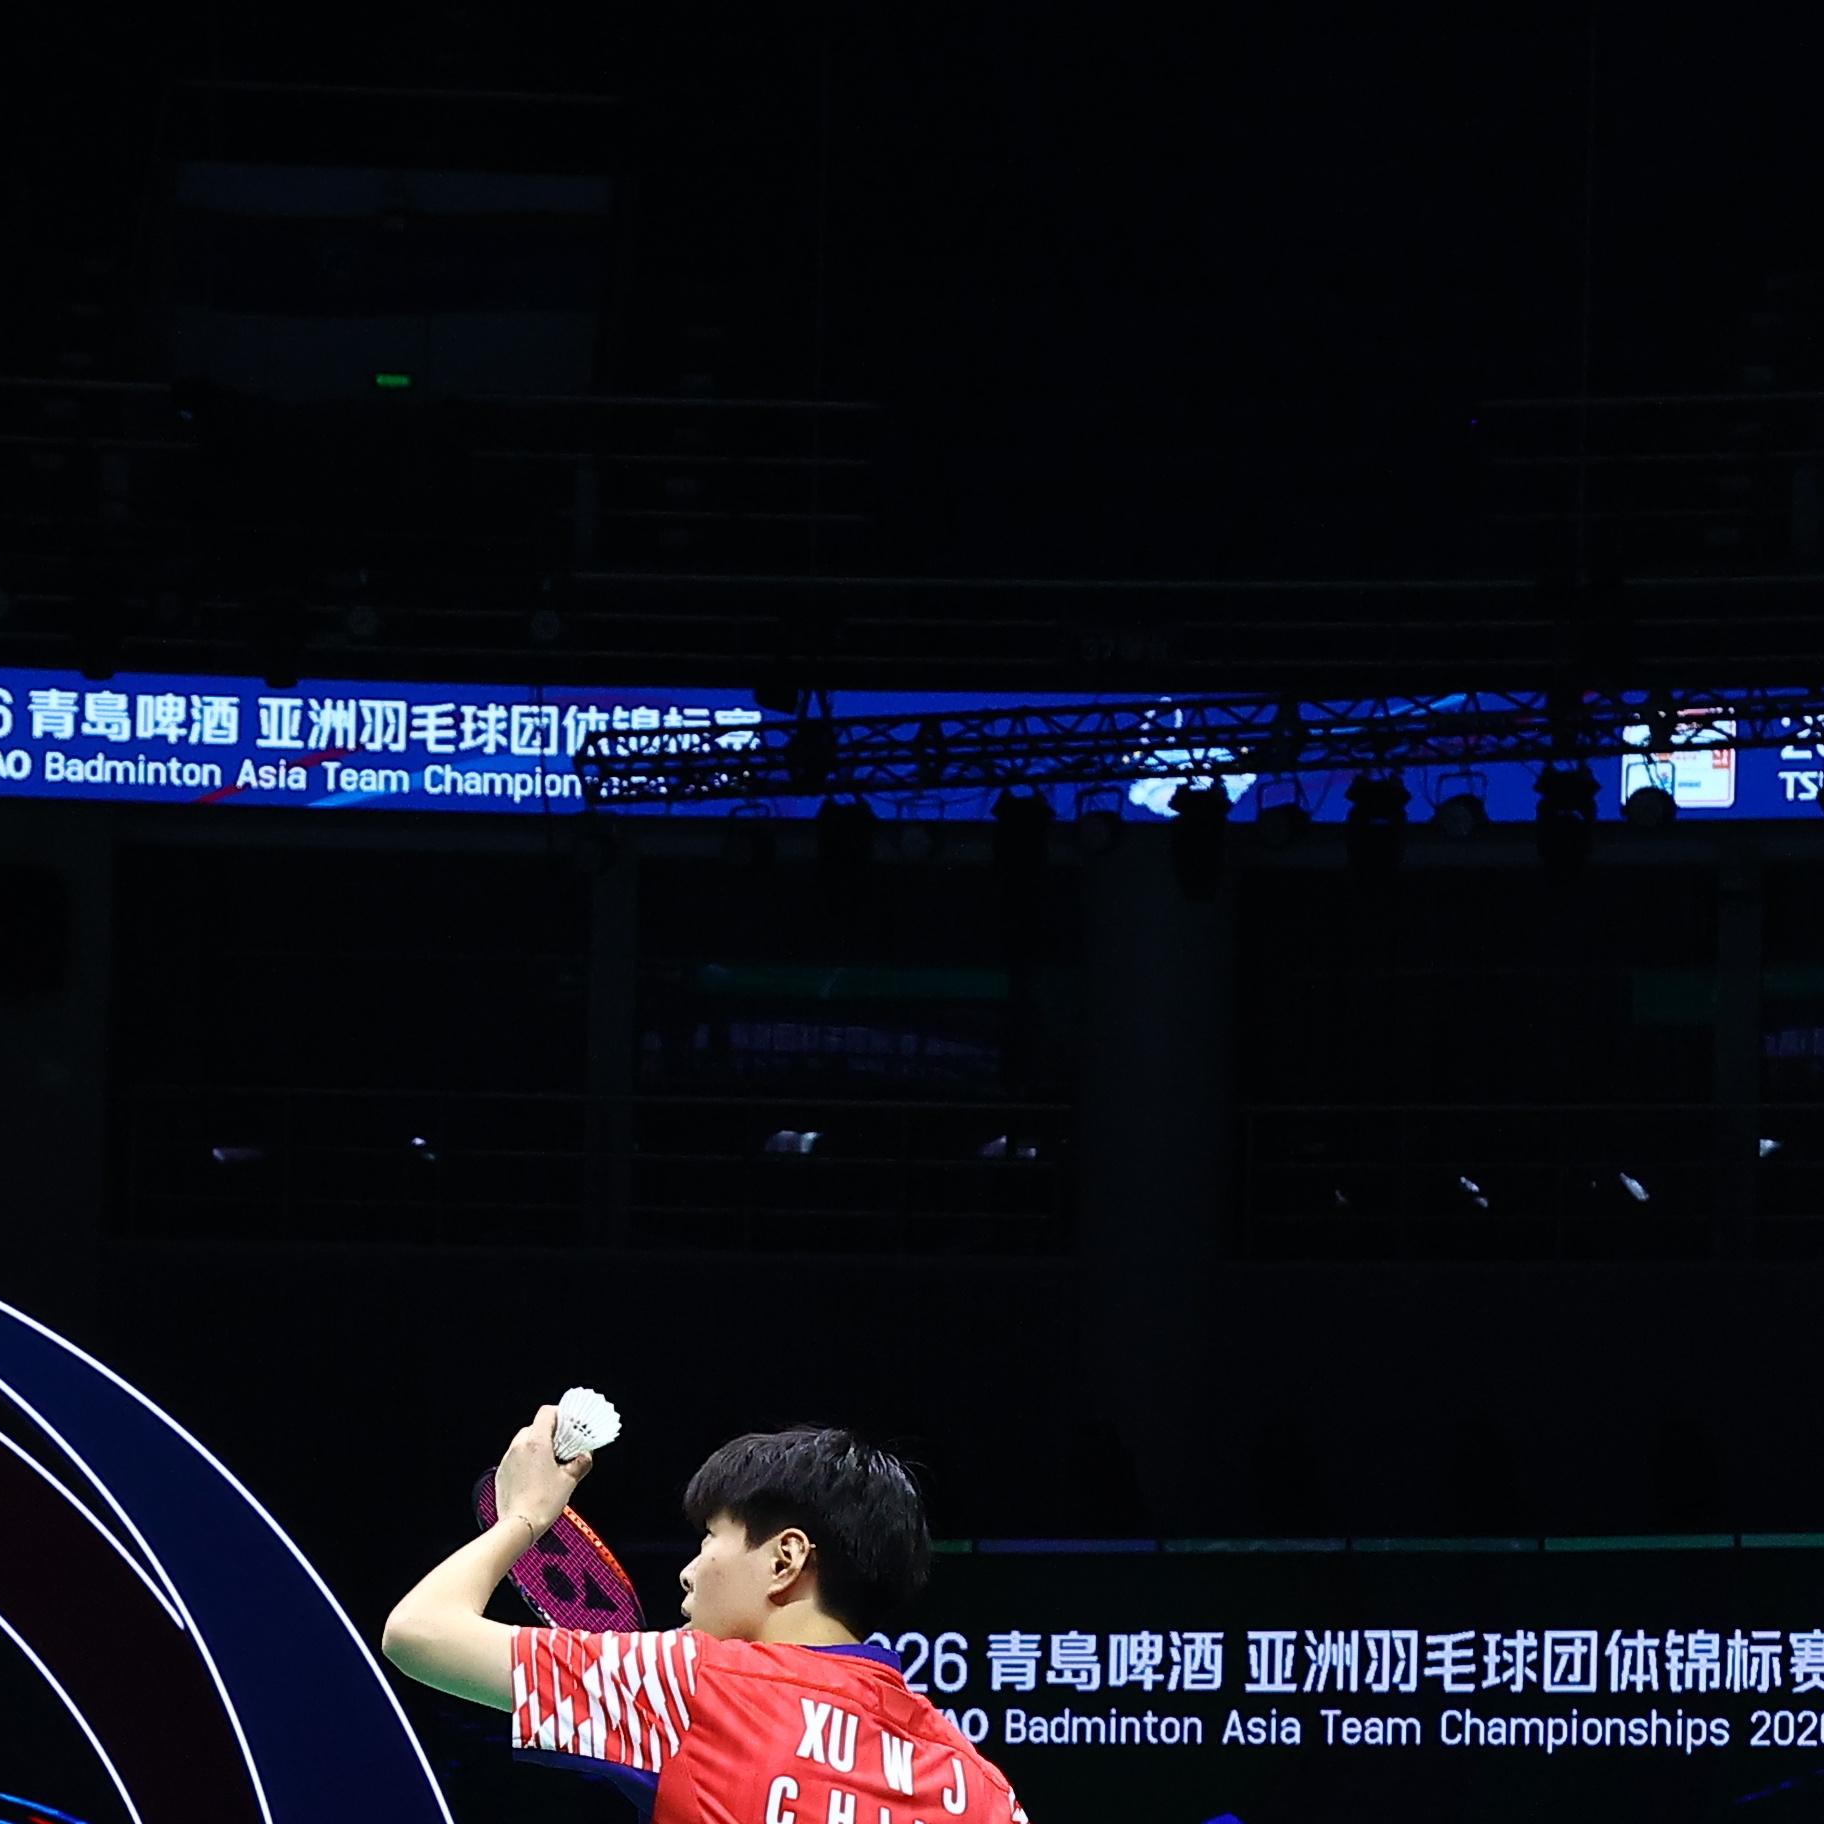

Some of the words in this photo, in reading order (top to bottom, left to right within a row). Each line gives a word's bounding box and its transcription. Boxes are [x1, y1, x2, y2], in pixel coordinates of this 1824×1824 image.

[28, 688, 241, 746] 青島啤酒
[43, 751, 223, 790] Badminton
[236, 758, 308, 793] Asia
[323, 761, 410, 795] Team
[986, 1630, 1226, 1693] 青島啤酒
[795, 1697, 860, 1774] XU
[880, 1729, 915, 1797] W
[942, 1757, 968, 1816] J
[1004, 1708, 1204, 1746] Badminton
[1222, 1708, 1302, 1746] Asia
[1320, 1708, 1422, 1747] Team
[1439, 1708, 1731, 1755] Championships
